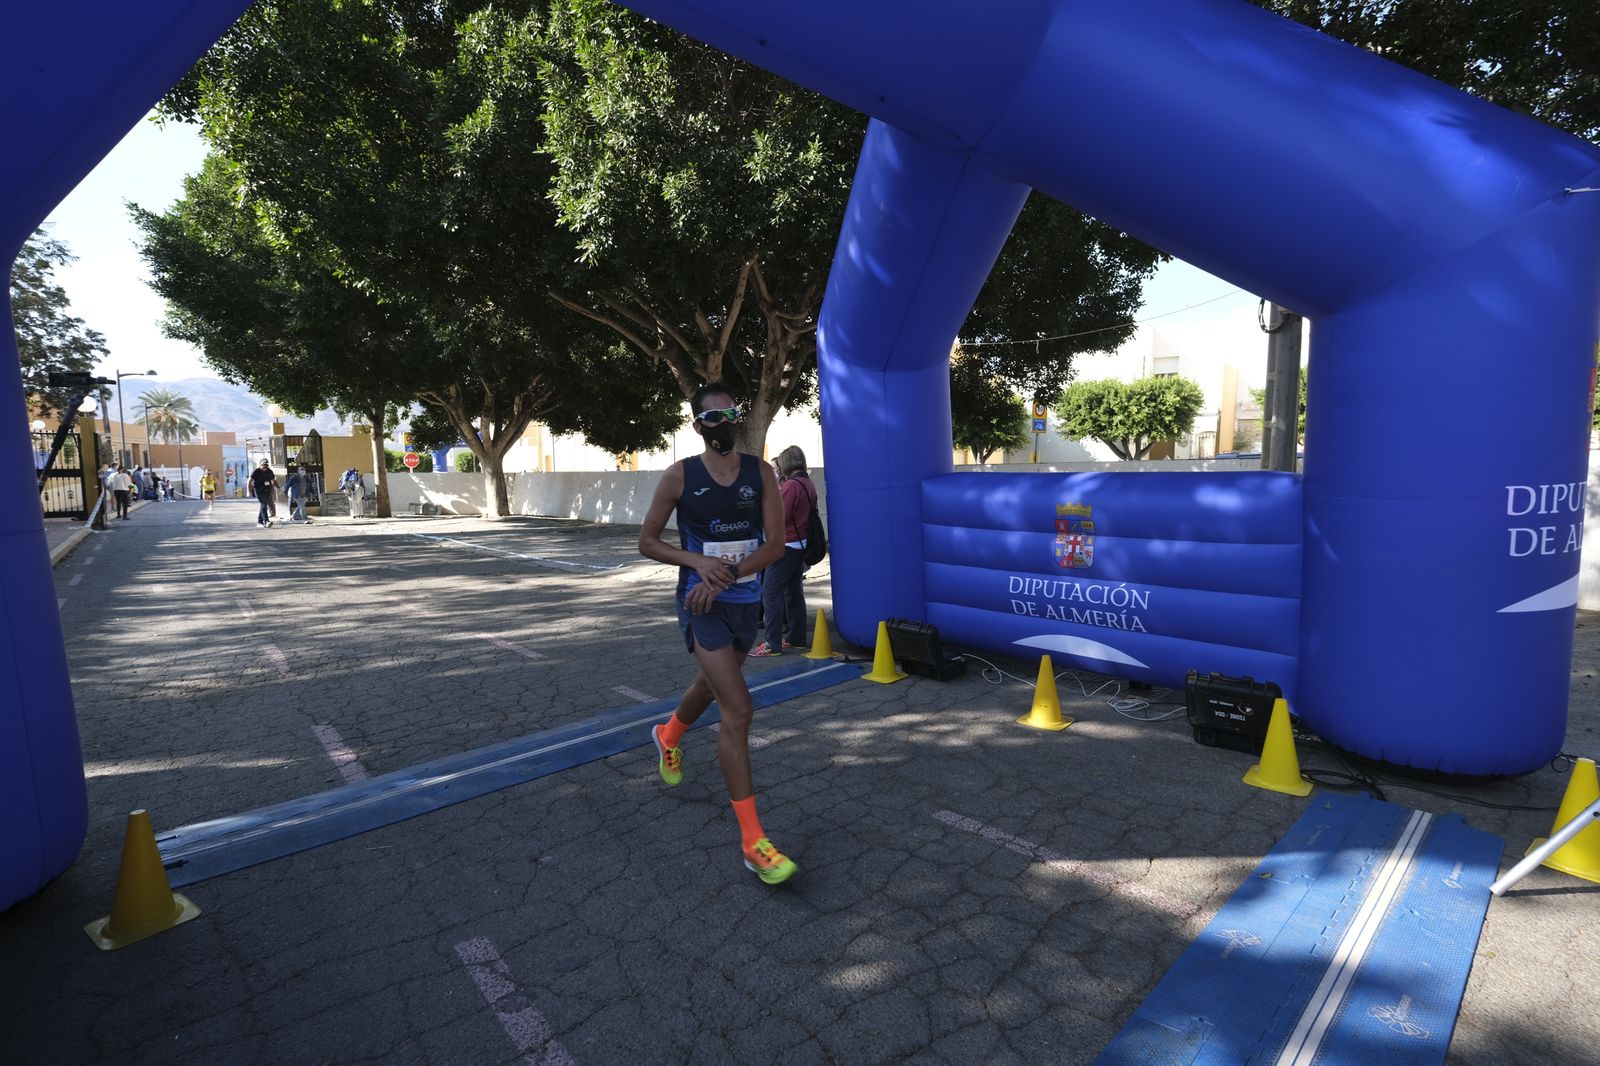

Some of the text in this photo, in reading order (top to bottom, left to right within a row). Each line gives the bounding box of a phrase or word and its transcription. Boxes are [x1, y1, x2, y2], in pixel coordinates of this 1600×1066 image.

[715, 520, 750, 533] DEHARO
[1507, 526, 1556, 557] DE
[1009, 576, 1151, 610] DIPUTACIÓN
[1011, 600, 1148, 633] DE ALMERÍA
